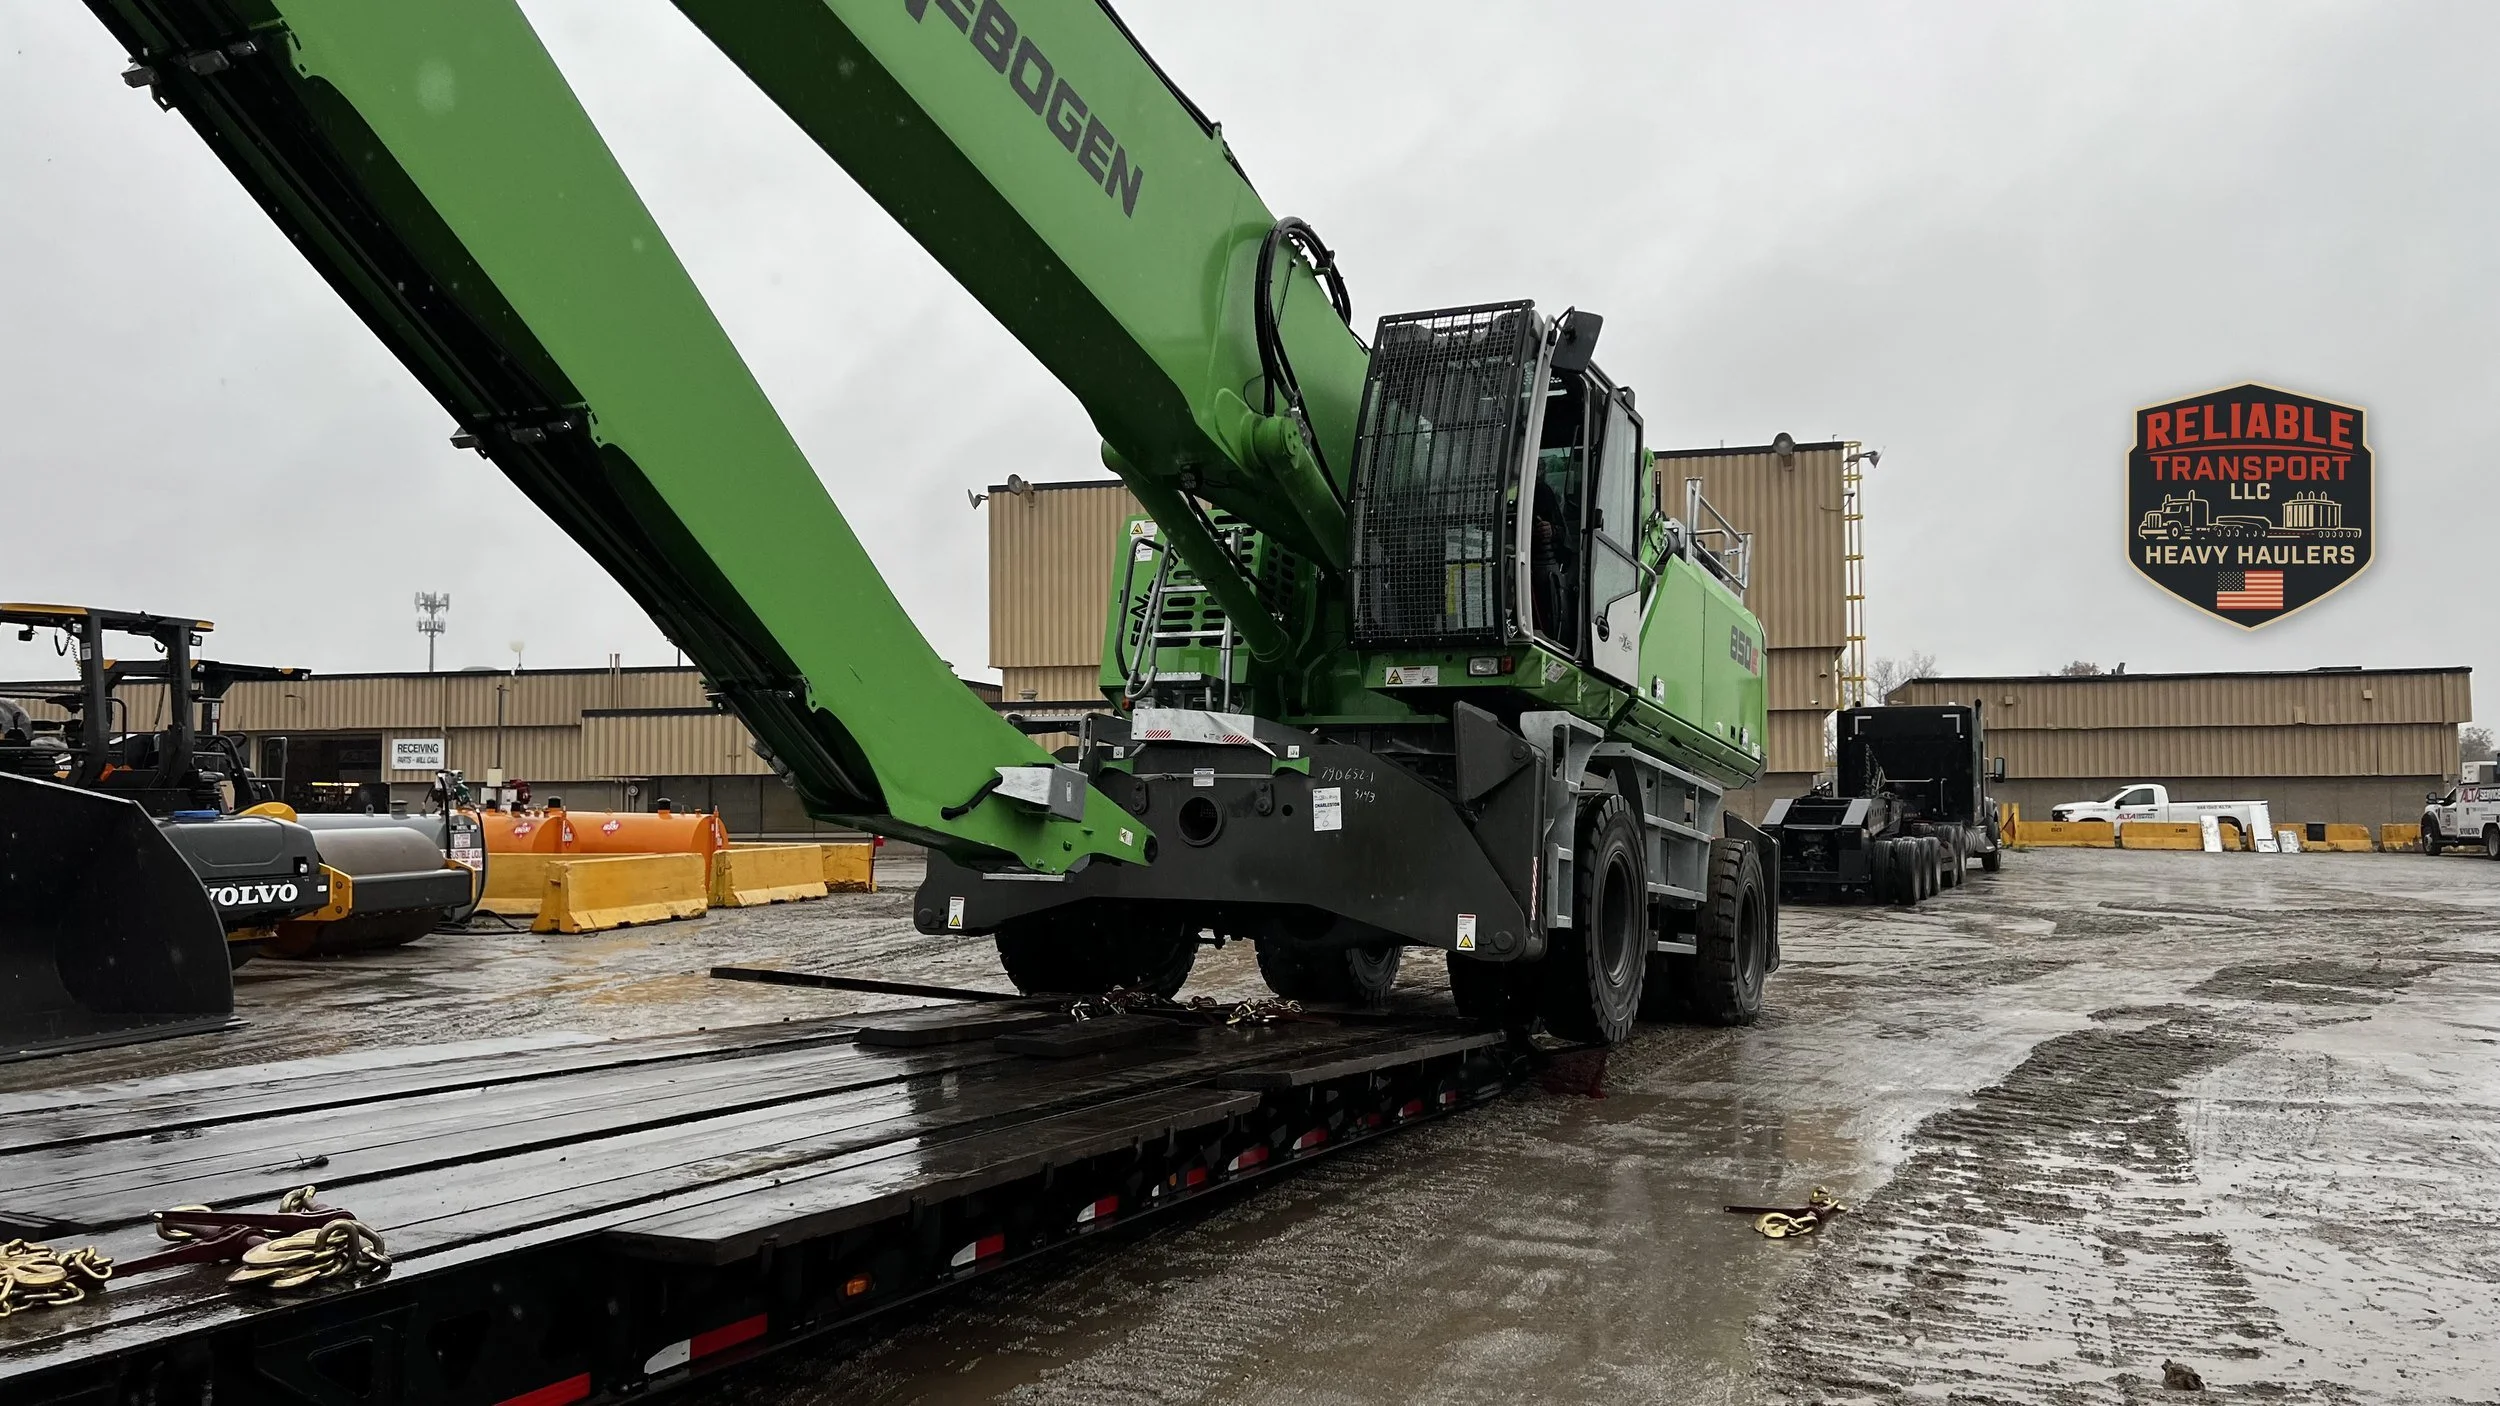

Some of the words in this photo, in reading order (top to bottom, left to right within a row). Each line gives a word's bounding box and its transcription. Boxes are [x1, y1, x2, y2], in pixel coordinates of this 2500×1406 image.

[397, 743, 439, 754] RECEIVING
[426, 756, 439, 764] CALL
[2461, 787, 2480, 803] ALTA
[2459, 828, 2480, 836] VOLVO
